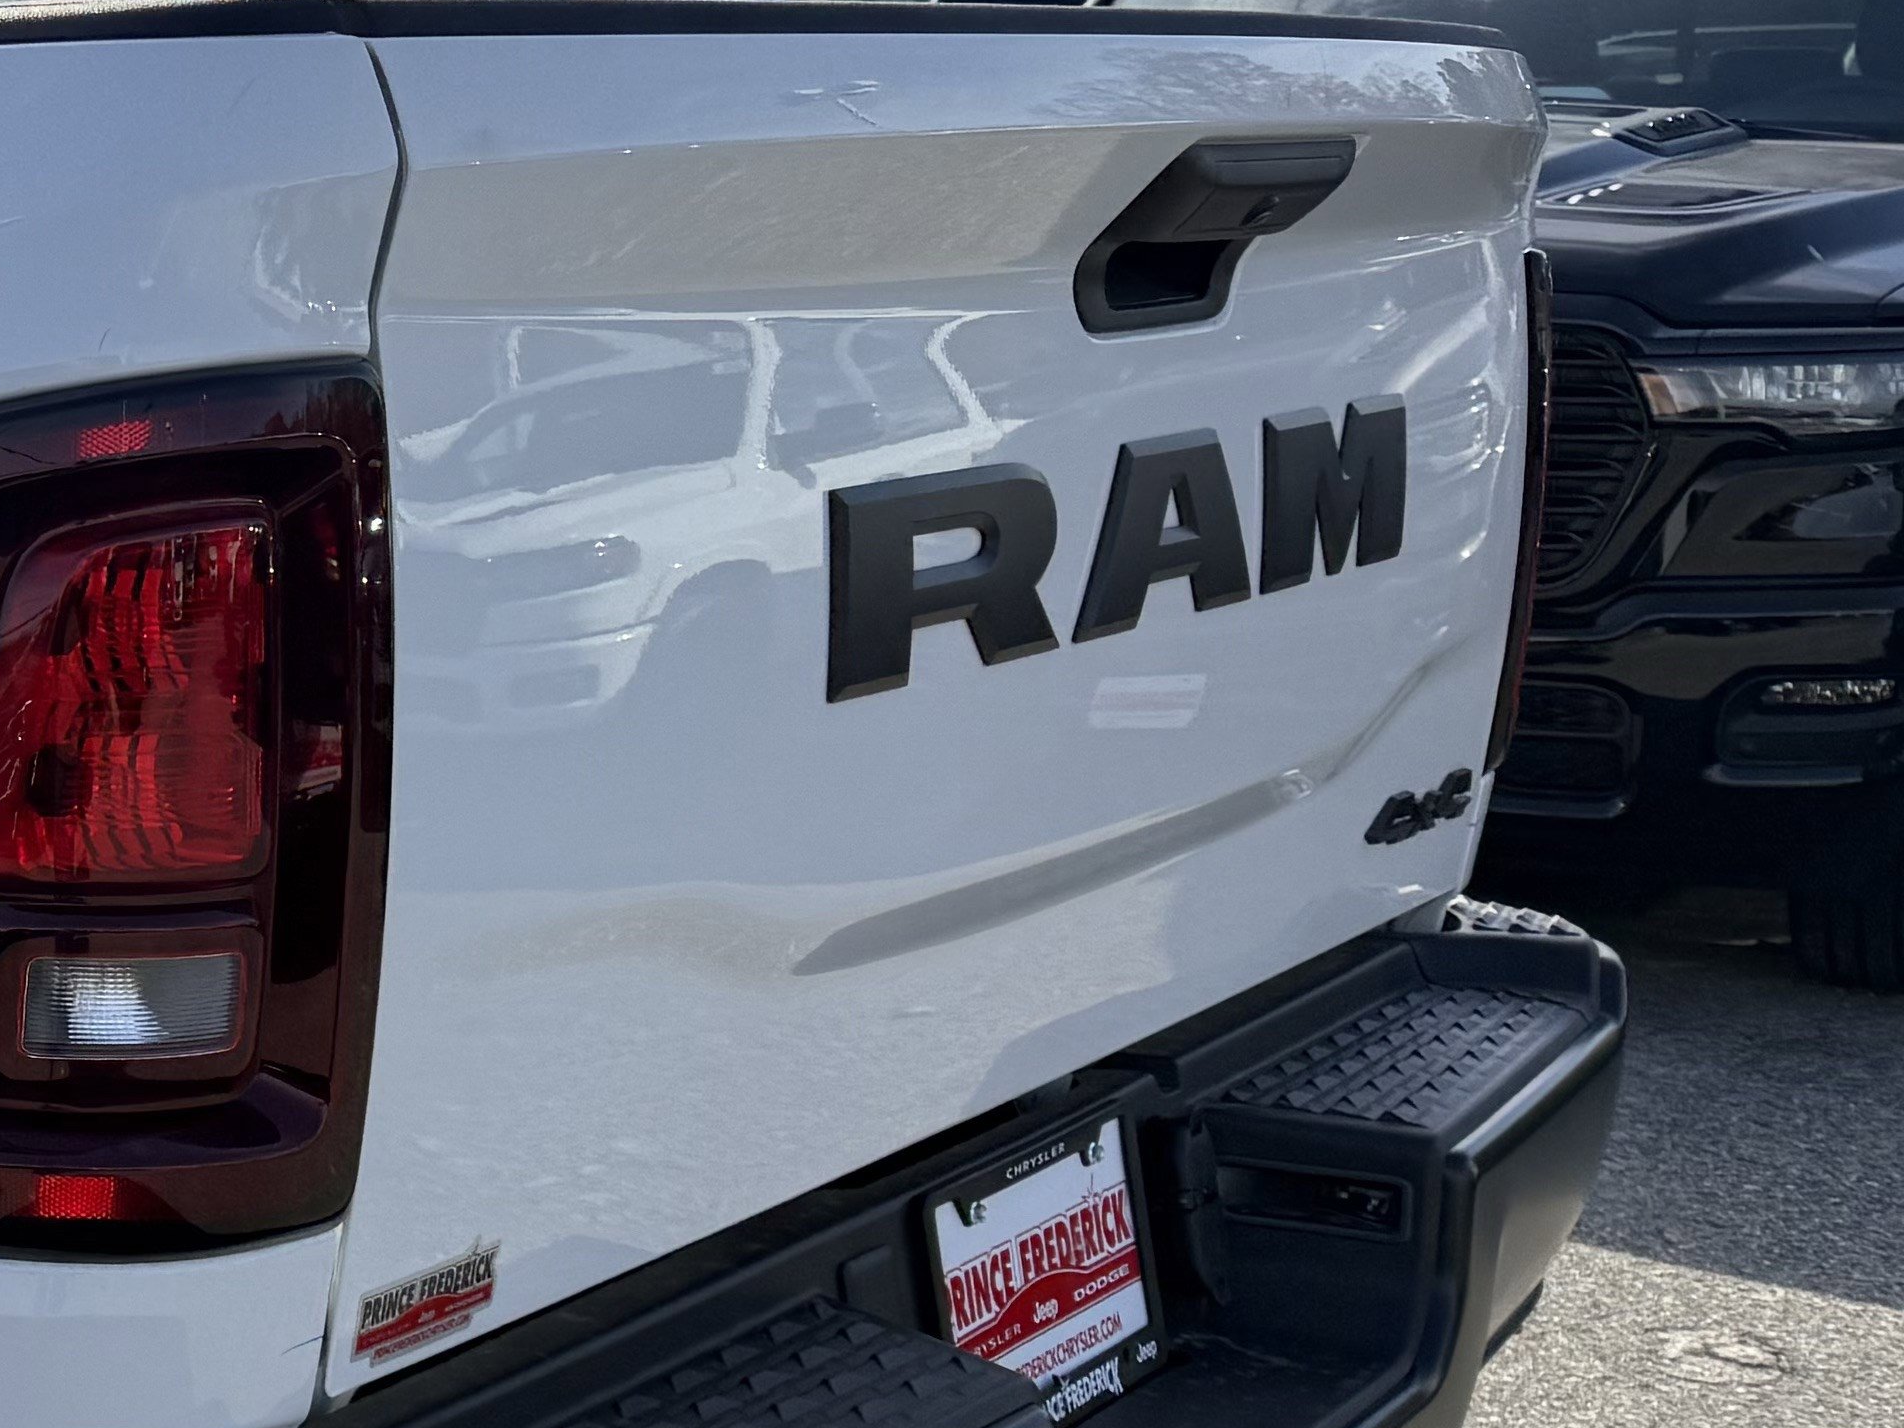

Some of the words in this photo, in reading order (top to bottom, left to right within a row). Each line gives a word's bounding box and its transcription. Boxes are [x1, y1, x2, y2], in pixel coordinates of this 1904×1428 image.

[825, 392, 1407, 704] RAM
[1005, 1141, 1066, 1180] CHRYSLER
[361, 1281, 417, 1330] PRINCE
[419, 1248, 498, 1301] FREDERICK
[948, 1245, 1016, 1332] RINCE
[1017, 1187, 1132, 1285] FREDERICK
[973, 1322, 1022, 1358] RYSLER
[1033, 1298, 1059, 1324] Jeep
[1073, 1263, 1130, 1303] DODGE
